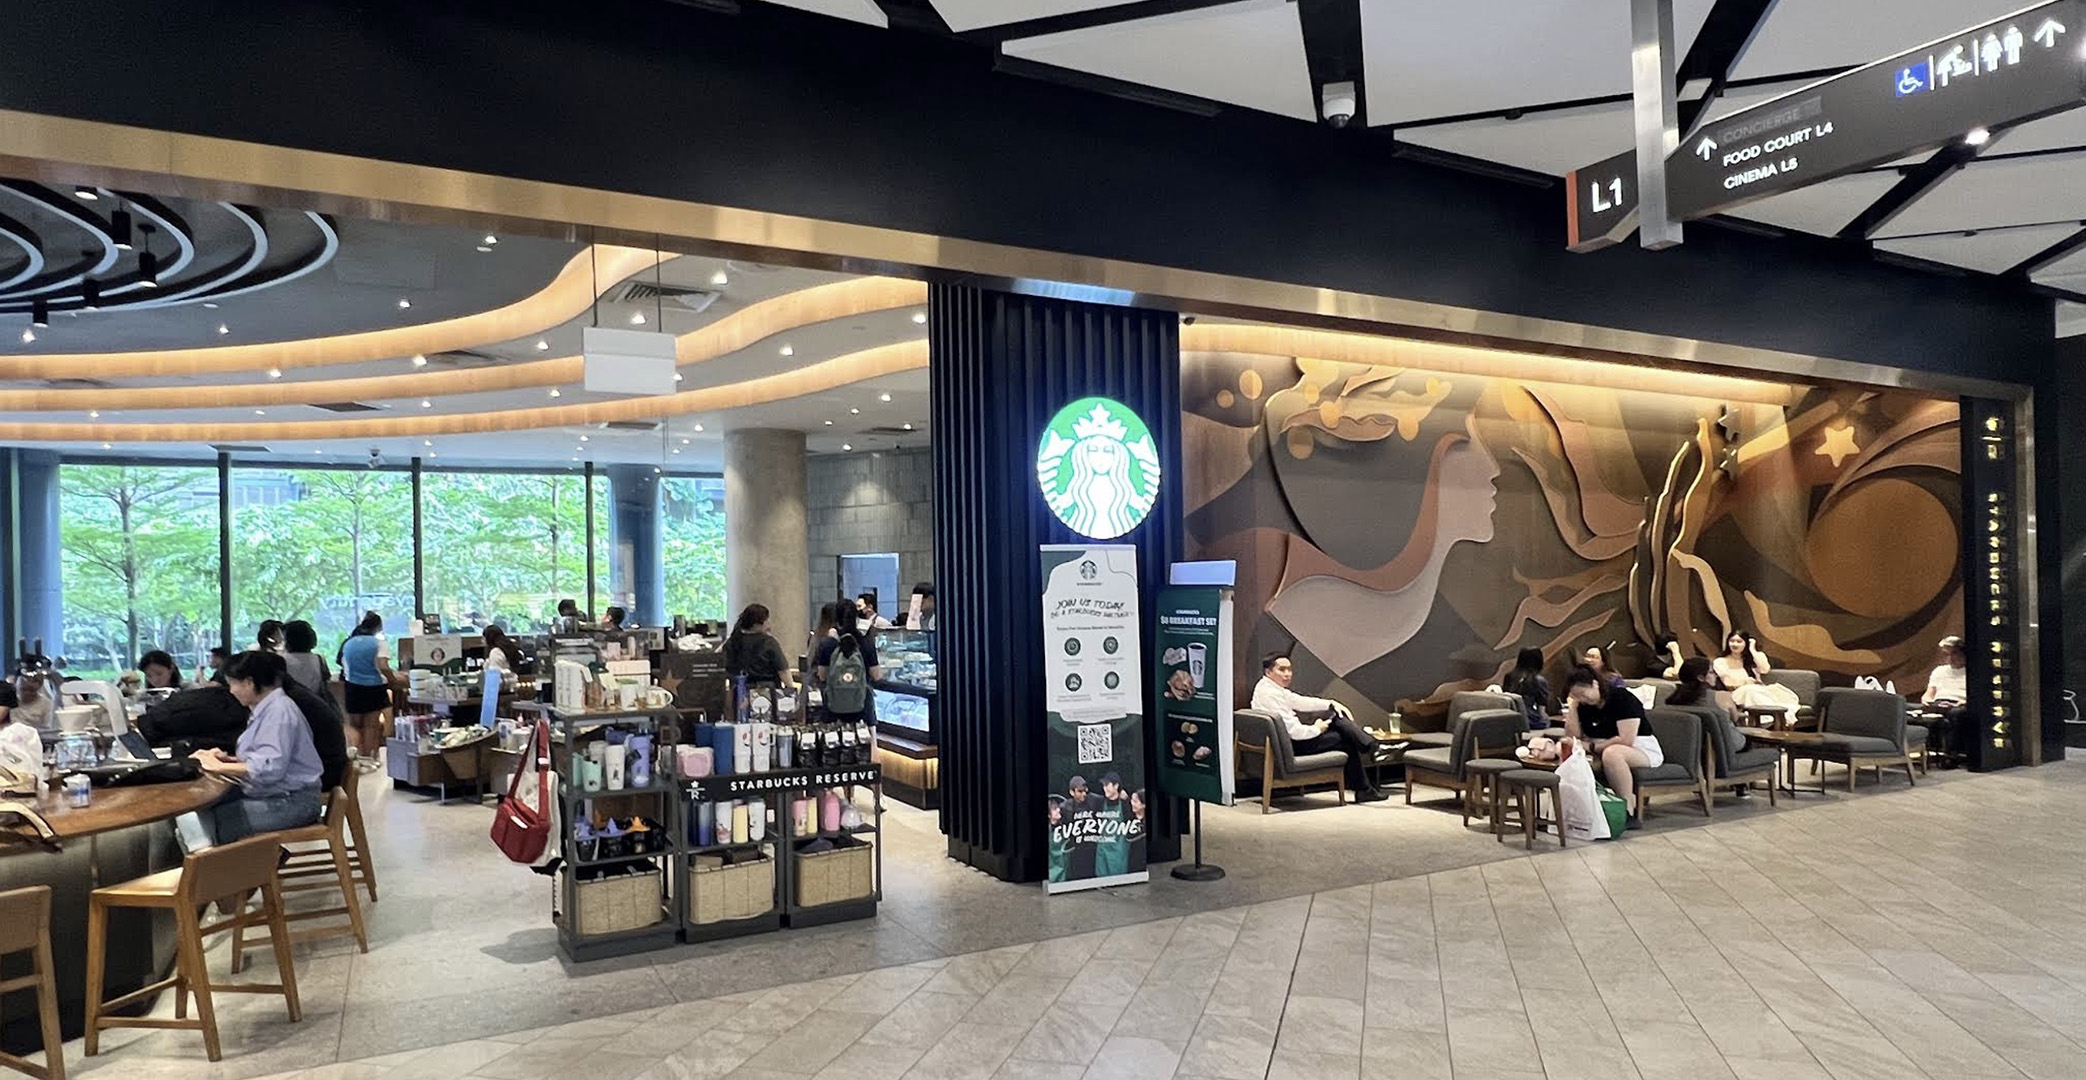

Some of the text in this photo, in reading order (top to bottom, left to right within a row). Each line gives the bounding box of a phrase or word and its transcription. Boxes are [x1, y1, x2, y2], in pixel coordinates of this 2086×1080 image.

[1723, 108, 1800, 143] CONCIERGE
[1723, 121, 1834, 167] FOOD COURT L4
[1723, 157, 1798, 189] CINEMA L5
[1592, 177, 1622, 212] L1
[1056, 598, 1077, 610] JOIN
[1079, 597, 1092, 607] US
[1169, 616, 1205, 625] BREAKFAST
[1205, 617, 1217, 626] SET
[730, 770, 875, 792] STARBUCKS RESERVE
[1053, 818, 1141, 843] EVERYONE
